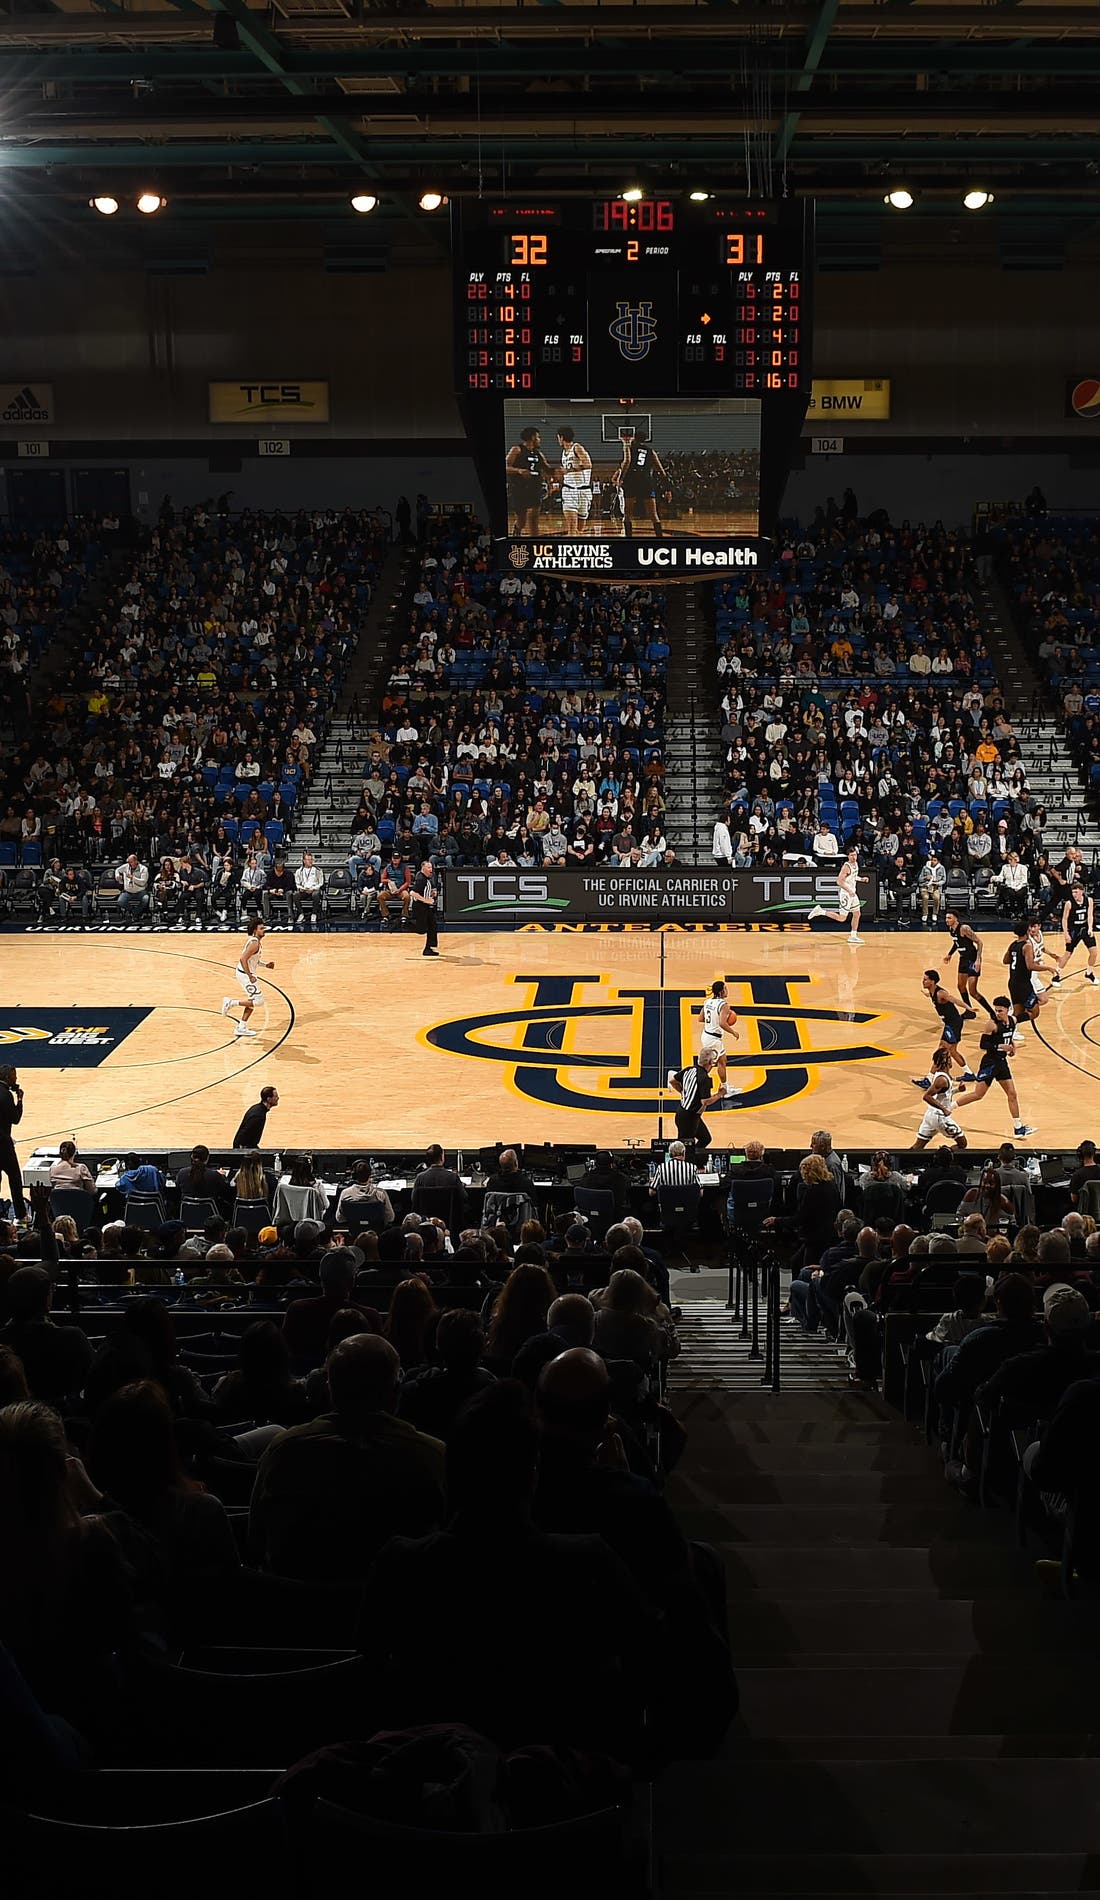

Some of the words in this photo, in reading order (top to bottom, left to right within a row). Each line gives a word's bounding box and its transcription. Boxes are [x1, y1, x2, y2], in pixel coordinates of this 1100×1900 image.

[603, 201, 674, 231] 19:06
[511, 235, 547, 265] 32
[627, 241, 638, 260] 2
[645, 247, 669, 255] PERIOD
[726, 234, 763, 264] 31
[469, 272, 485, 282] PLY
[496, 272, 512, 282] PTS
[520, 272, 531, 282] FL
[738, 271, 753, 281] PLY
[765, 271, 781, 281] PTS
[789, 271, 799, 281] FL
[467, 283, 487, 299] 22
[504, 283, 514, 299] 4
[521, 283, 530, 299] 0
[746, 283, 756, 299] 5
[773, 283, 783, 299] 2
[789, 283, 799, 299] 0
[500, 306, 514, 321] 10
[741, 306, 756, 321] 13
[772, 305, 783, 321] 2
[789, 305, 799, 321] 0
[505, 329, 515, 344] 2
[521, 329, 531, 344] 0
[544, 335, 559, 344] FLS
[569, 335, 584, 344] TOL
[686, 334, 702, 344] FLS
[712, 334, 727, 344] TOL
[772, 328, 782, 343] 4
[479, 351, 488, 366] 3
[505, 351, 515, 366] 0
[572, 347, 581, 362] 3
[715, 346, 724, 361] 3
[745, 351, 755, 366] 3
[772, 351, 782, 366] 0
[788, 351, 798, 366] 0
[469, 373, 488, 388] 43
[506, 373, 515, 388] 4
[521, 373, 531, 388] 0
[745, 373, 754, 388] 2
[767, 373, 781, 388] 16
[788, 373, 798, 388] 0
[239, 385, 301, 403] TCS
[821, 396, 863, 409] BMW
[2, 408, 49, 421] adidas
[24, 443, 41, 454] 101
[263, 441, 283, 453] 102
[817, 440, 837, 451] 104
[533, 545, 553, 557] UC
[557, 544, 610, 557] IRVINE
[637, 548, 677, 565] UCI
[685, 547, 758, 565] Health
[533, 556, 613, 569] ATHLETICS
[457, 875, 548, 901] TCS
[583, 878, 606, 891] THE
[609, 878, 663, 891] OFFICIAL
[666, 878, 718, 891] CARRIER
[719, 878, 739, 891] OF
[752, 876, 840, 902] TCS
[598, 894, 615, 907] UC
[618, 894, 658, 907] IRVINE
[661, 894, 726, 907] ATHLETICS
[514, 922, 813, 932] ANTEATERS
[705, 1010, 711, 1023] 3
